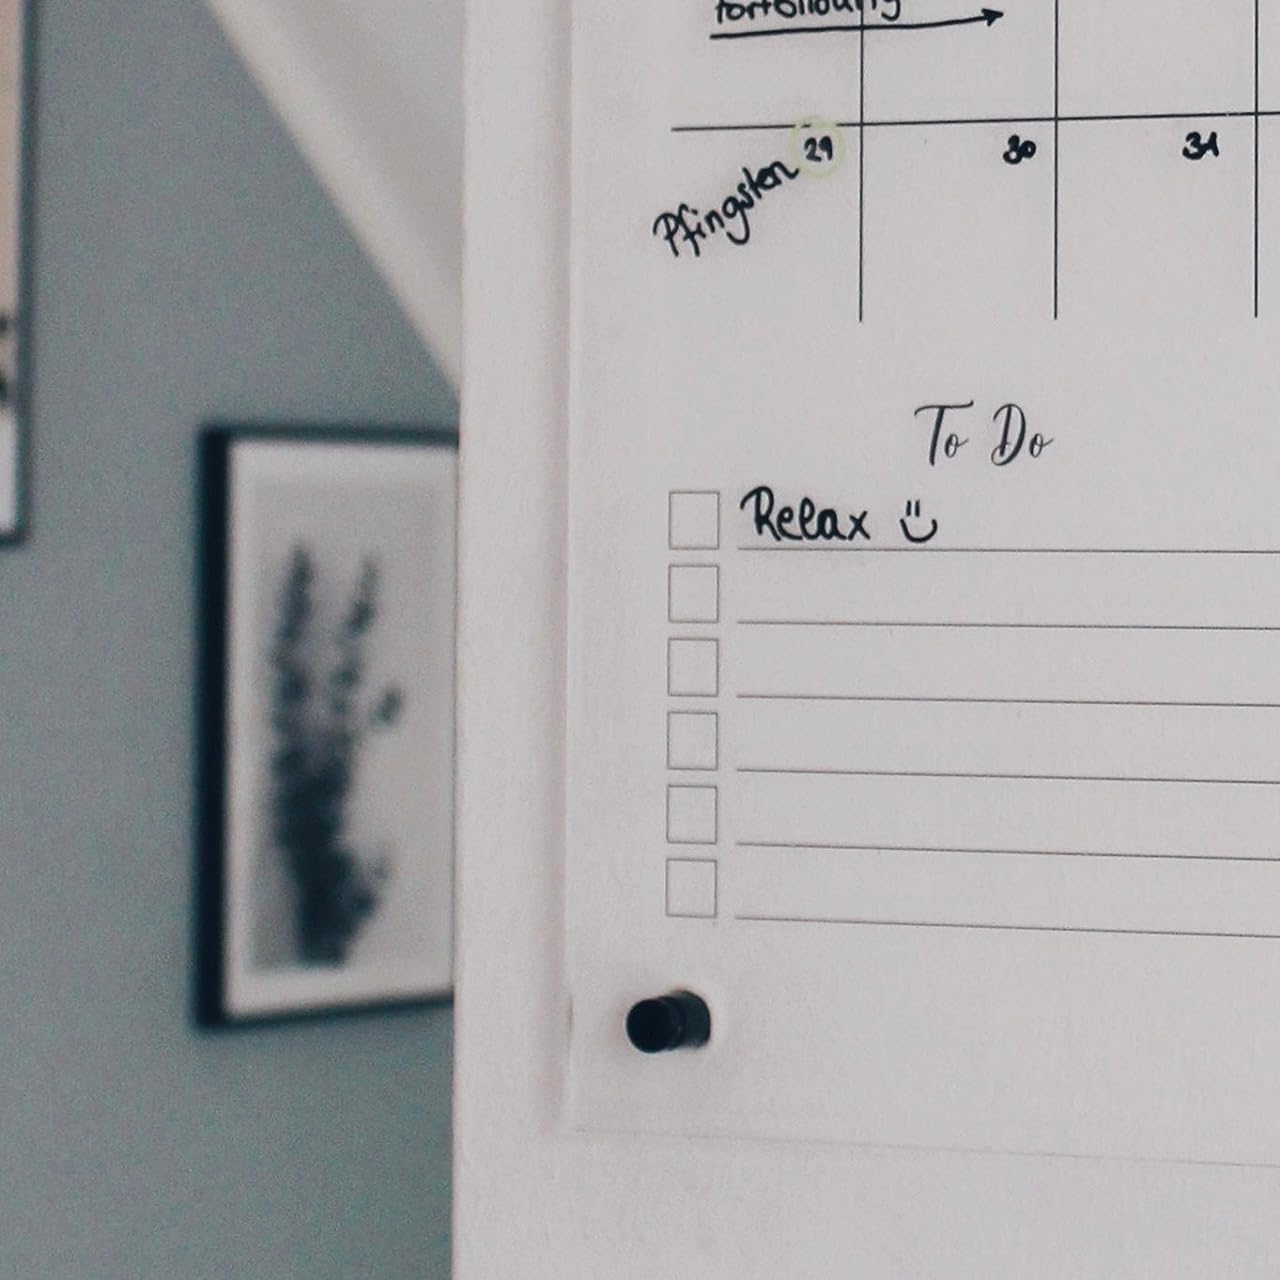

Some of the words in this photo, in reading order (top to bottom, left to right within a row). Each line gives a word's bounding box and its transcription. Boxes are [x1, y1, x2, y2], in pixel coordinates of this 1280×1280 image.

[803, 135, 834, 163] 29
[1002, 133, 1037, 166] 30
[1181, 130, 1220, 161] 31
[652, 160, 802, 258] Pfingsten
[913, 400, 974, 467] To
[990, 403, 1055, 467] Do
[739, 486, 871, 542] Relax
